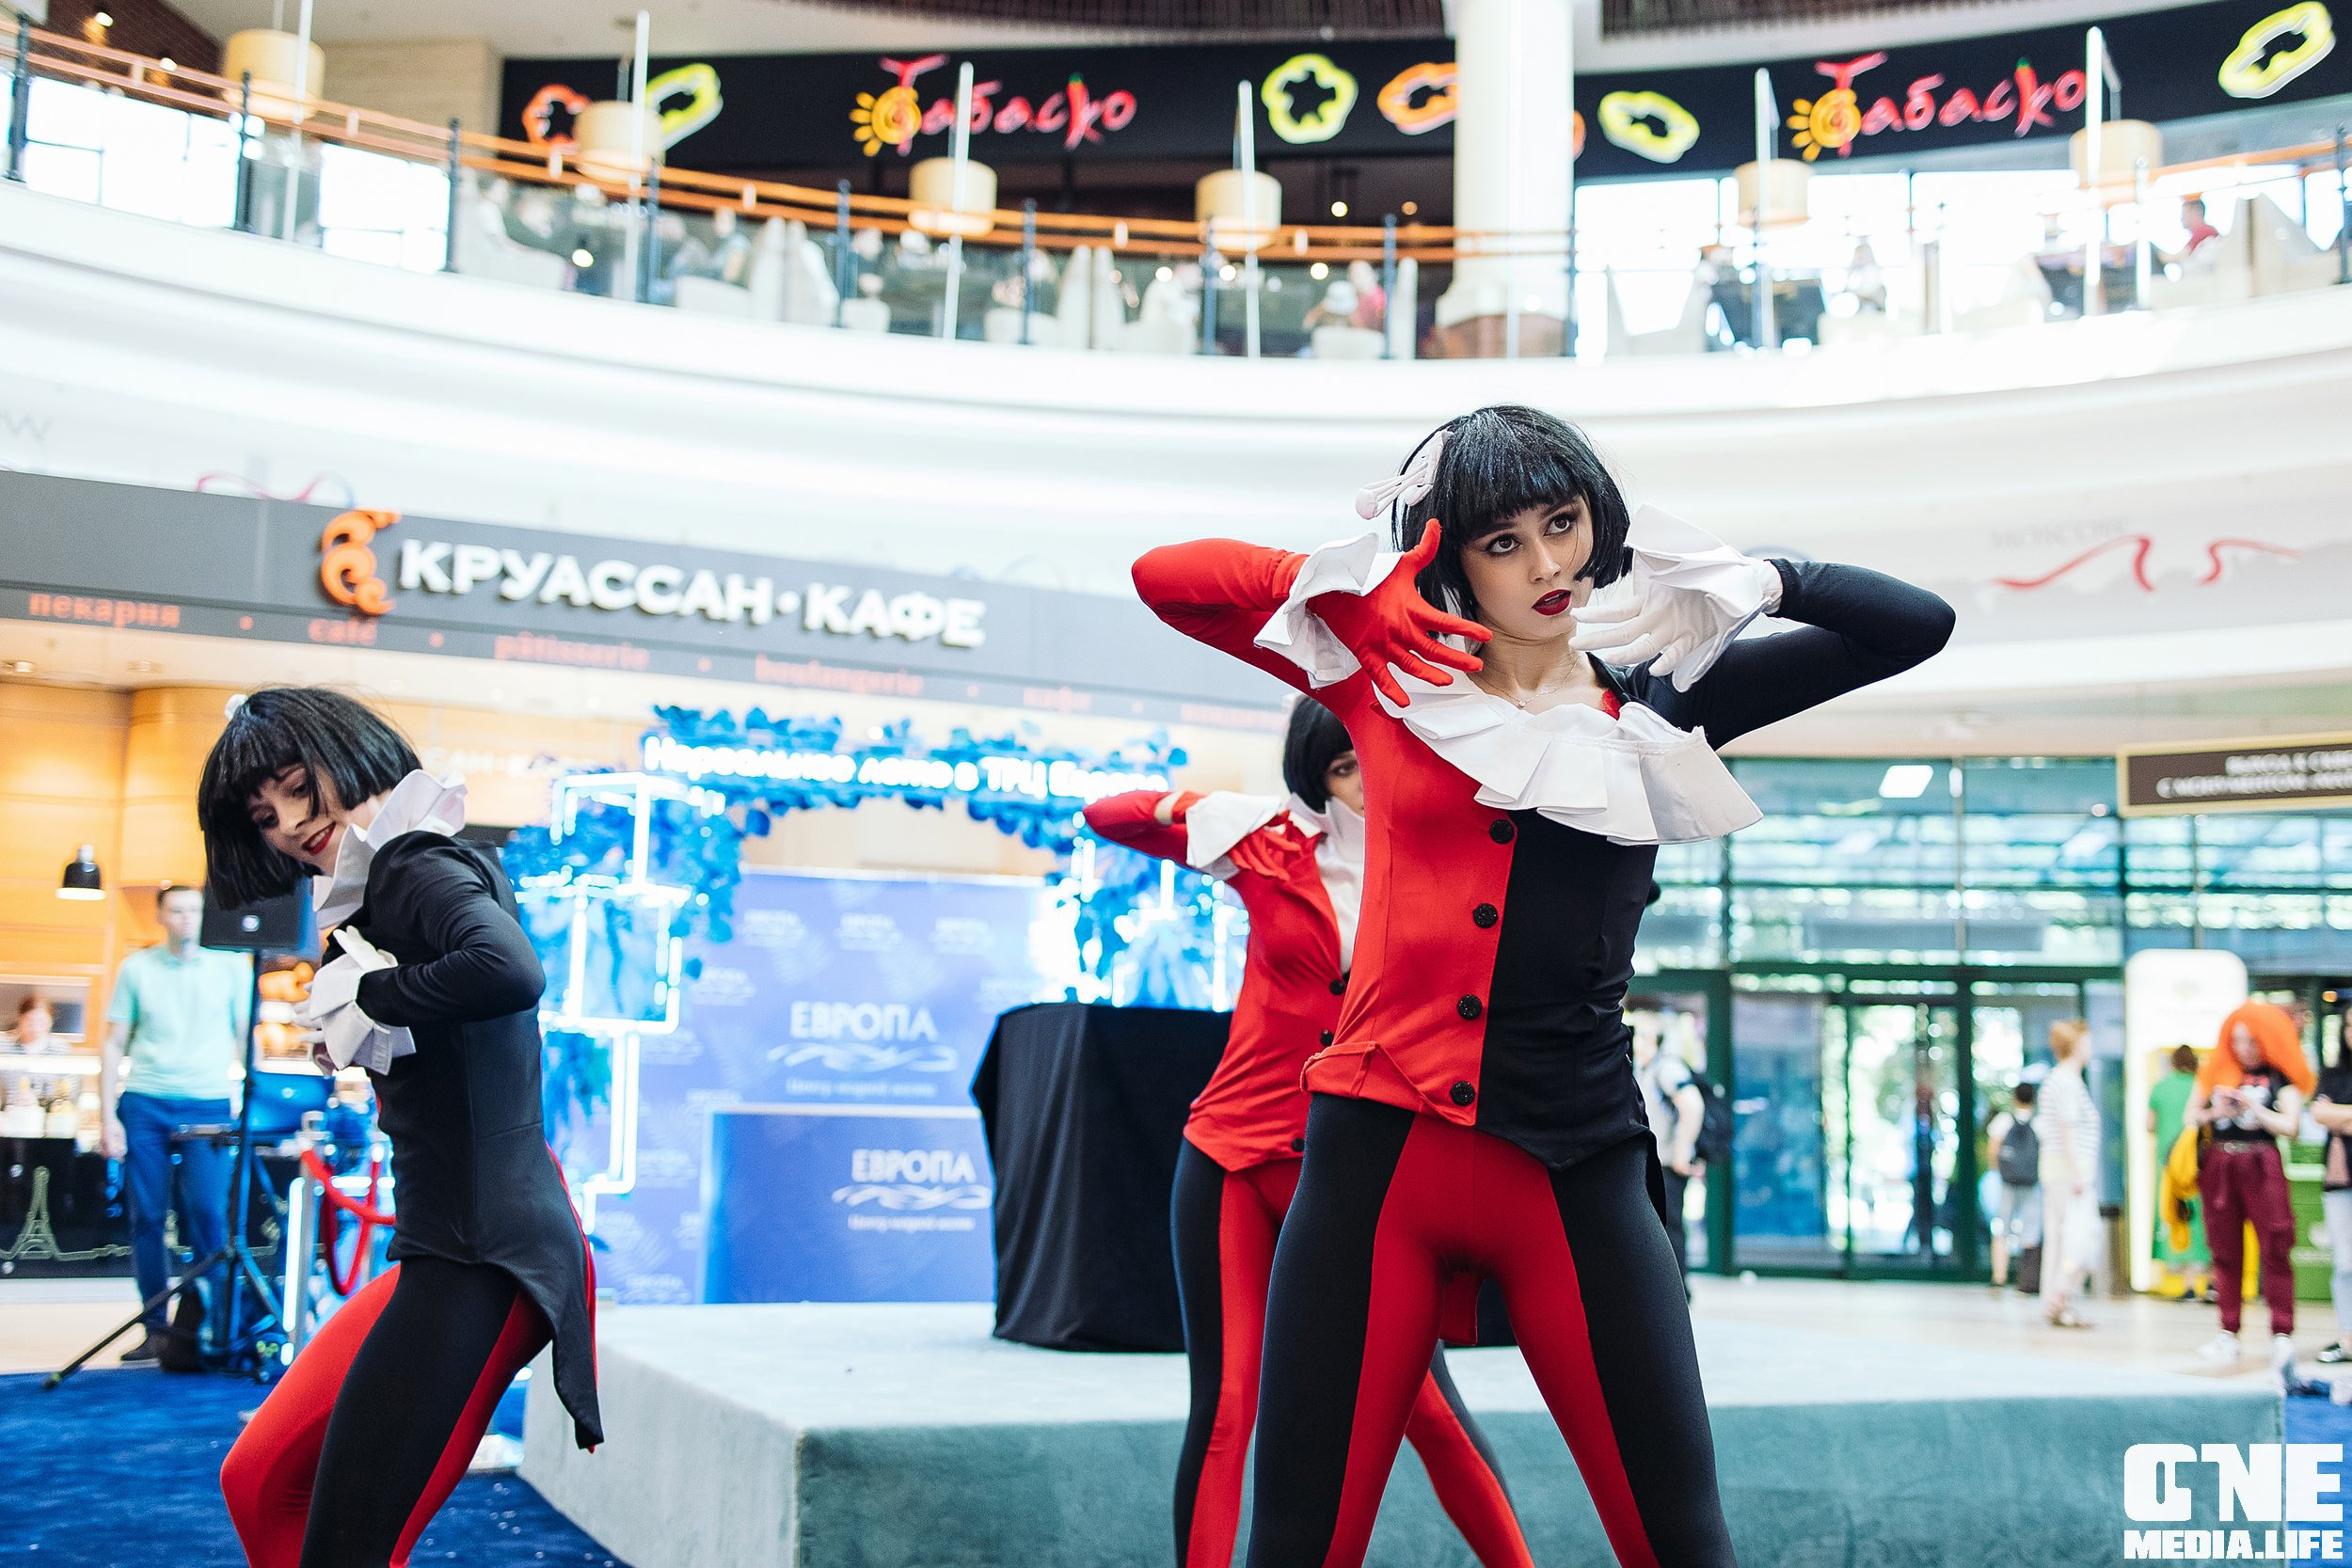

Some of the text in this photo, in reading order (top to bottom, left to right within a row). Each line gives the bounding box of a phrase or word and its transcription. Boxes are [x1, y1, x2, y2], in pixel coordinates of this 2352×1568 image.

[29, 593, 181, 628] пекарня
[400, 538, 986, 648] КРУАССАН КАФЕ
[790, 1000, 939, 1043] ЕВРОПА
[851, 1148, 977, 1184] ЕВРОПА
